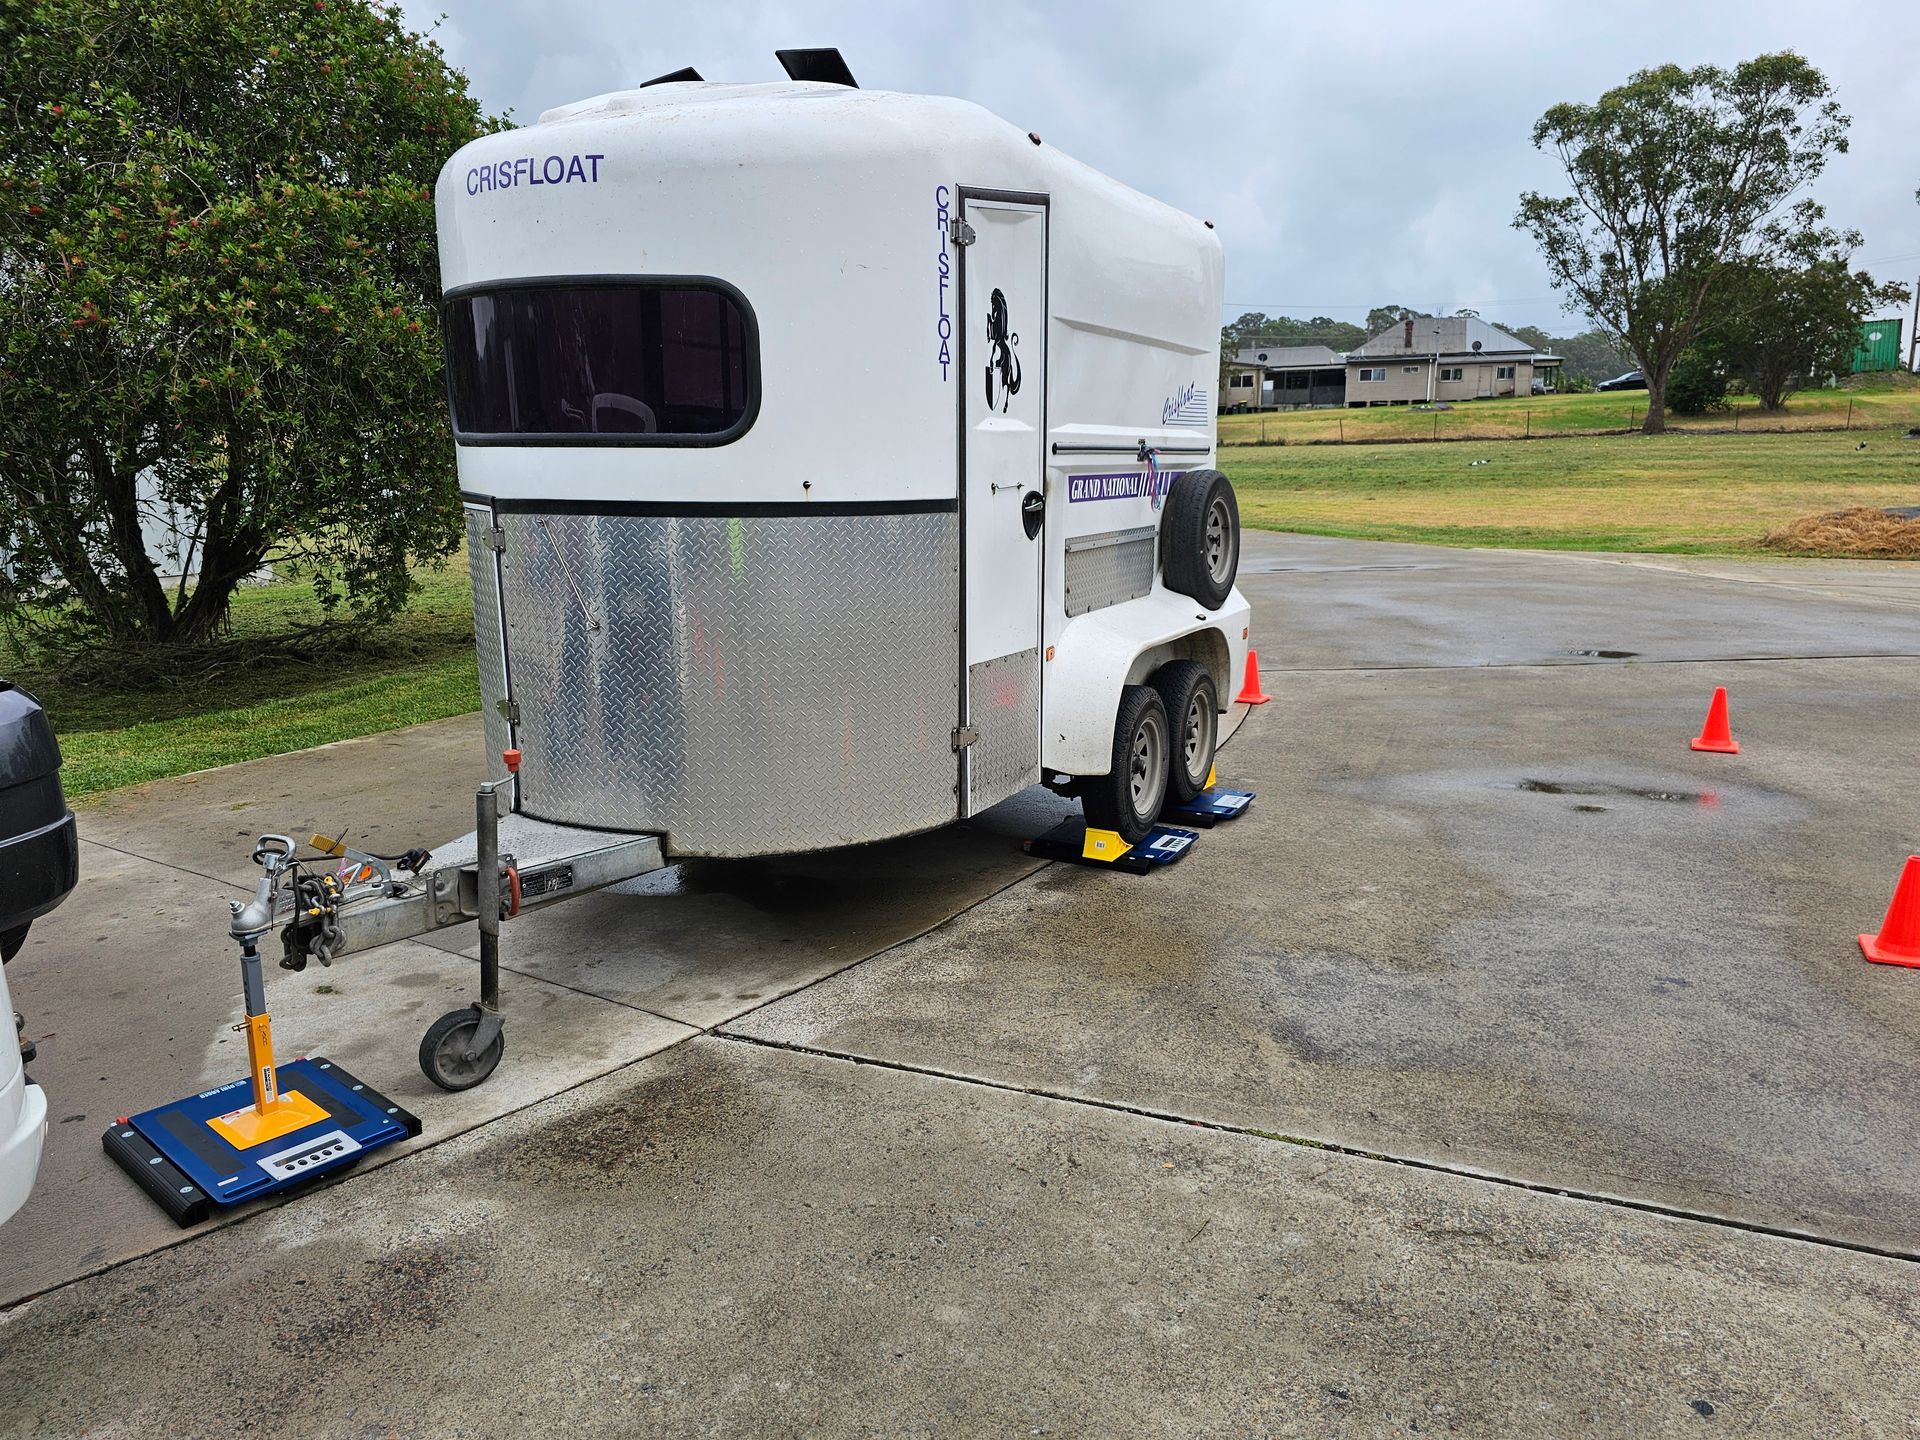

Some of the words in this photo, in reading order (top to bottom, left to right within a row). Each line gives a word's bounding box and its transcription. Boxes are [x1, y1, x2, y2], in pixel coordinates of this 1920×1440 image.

[466, 154, 605, 196] CRISFLOAT
[935, 185, 951, 382] CRISFLOAT
[1071, 479, 1101, 500] GRAND
[1100, 477, 1139, 498] NATIONAL
